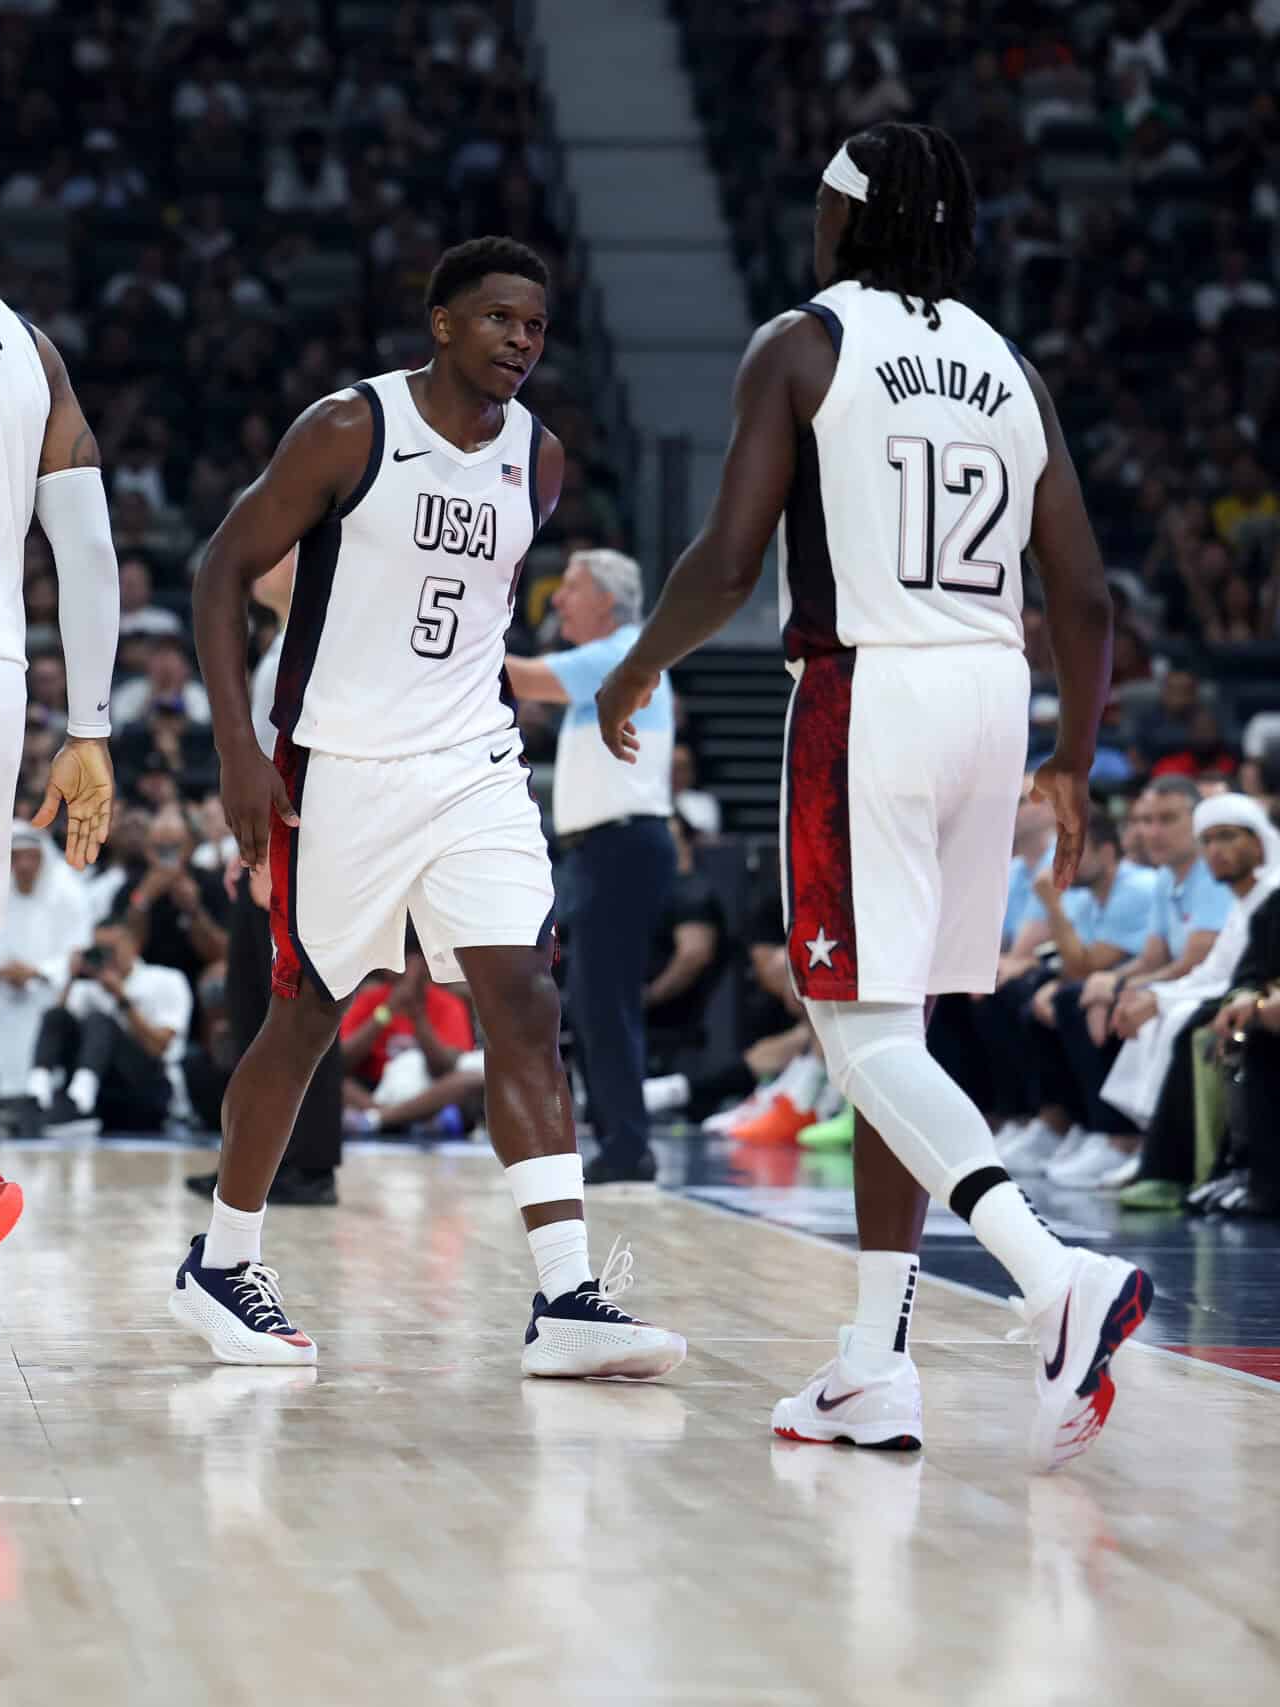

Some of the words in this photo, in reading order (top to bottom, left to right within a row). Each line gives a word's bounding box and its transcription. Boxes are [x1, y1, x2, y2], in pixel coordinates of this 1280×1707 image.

[875, 354, 1012, 418] HOLIDAY
[413, 492, 497, 561] USA
[886, 436, 1009, 596] 12
[410, 575, 466, 660] 5
